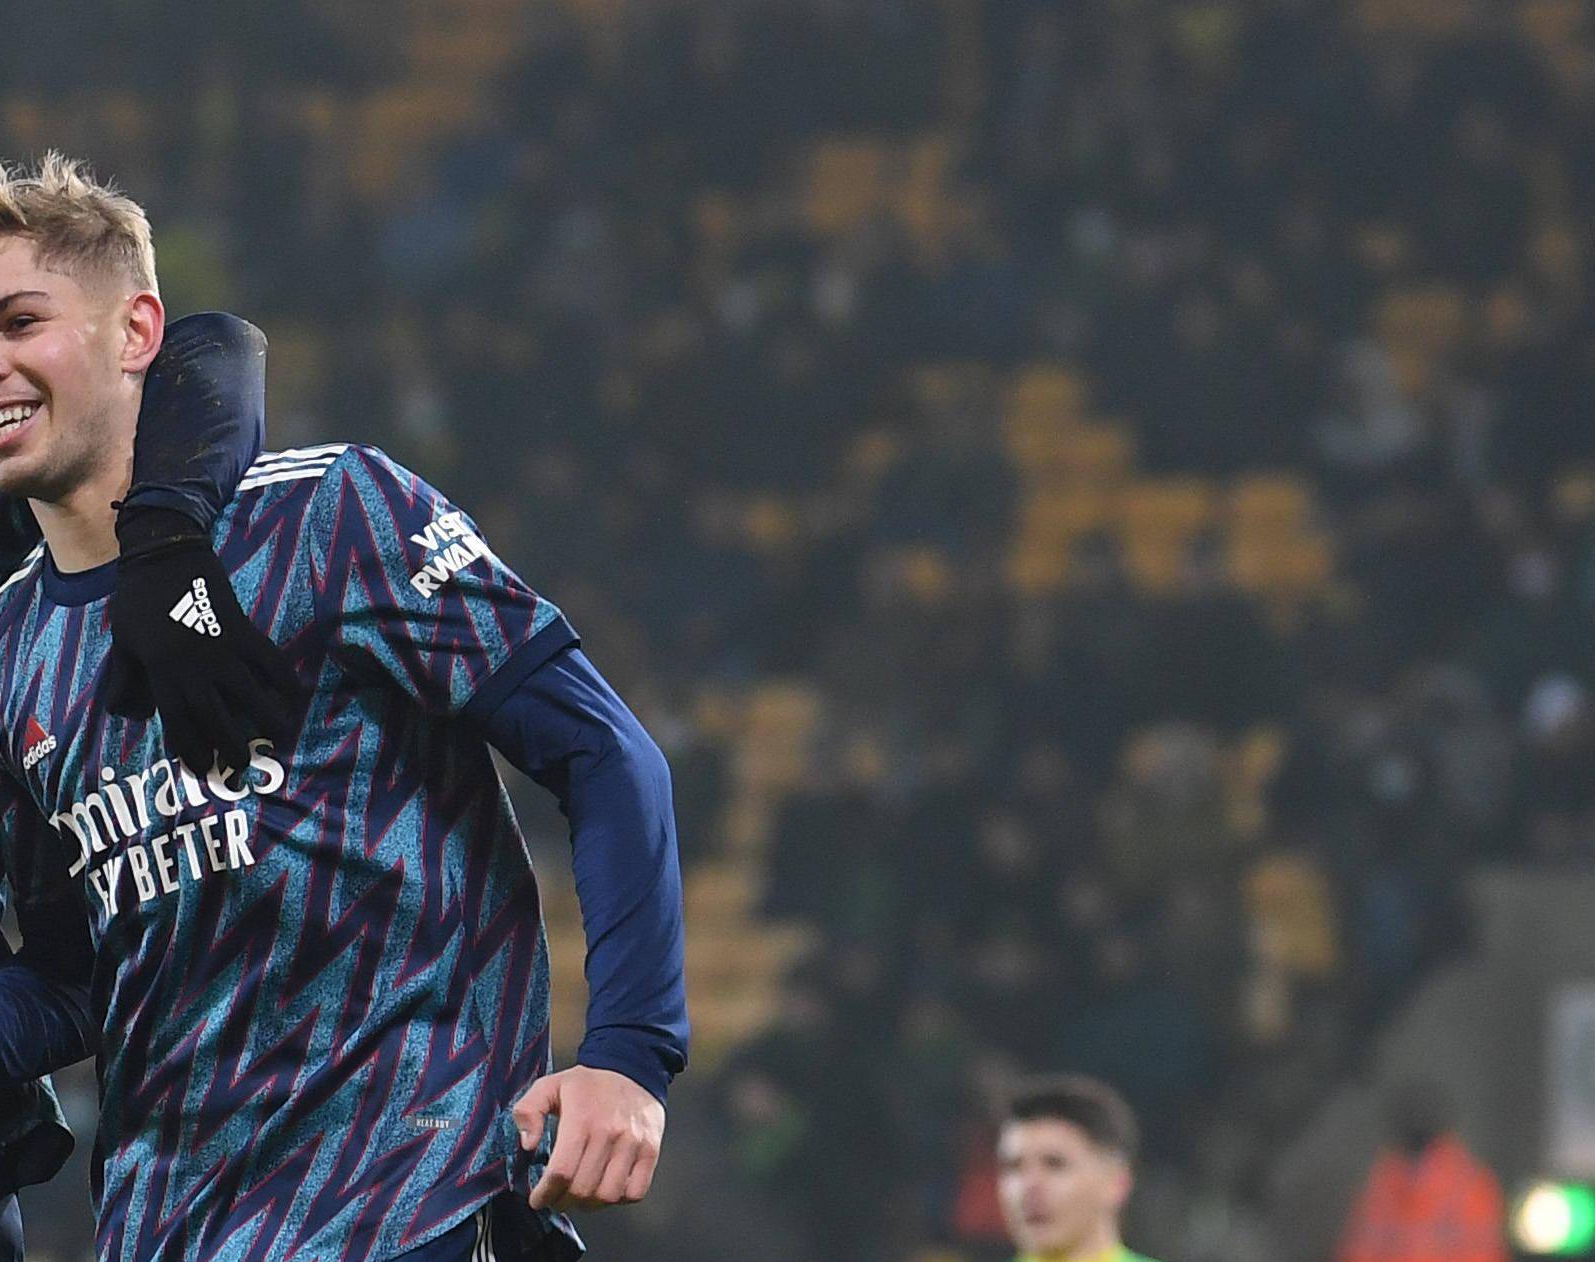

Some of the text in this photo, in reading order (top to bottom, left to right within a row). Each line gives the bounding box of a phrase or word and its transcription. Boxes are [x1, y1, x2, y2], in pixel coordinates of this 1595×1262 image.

[191, 577, 222, 637] adidas
[22, 735, 57, 770] adidas
[88, 808, 256, 917] FY BETER
